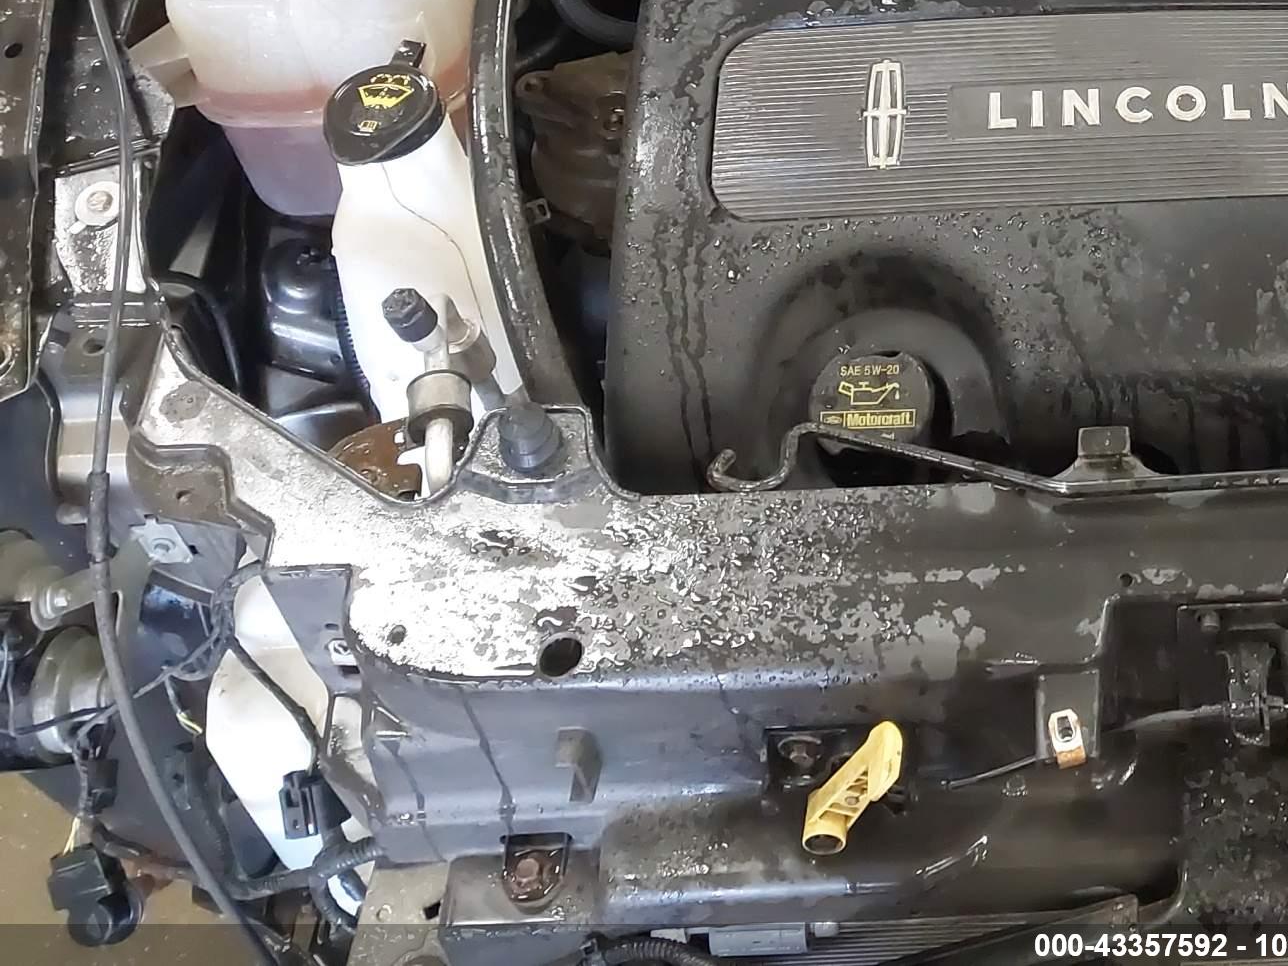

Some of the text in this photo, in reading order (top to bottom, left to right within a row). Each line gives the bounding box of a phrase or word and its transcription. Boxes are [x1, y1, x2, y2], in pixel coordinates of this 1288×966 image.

[840, 364, 900, 376] SAE 5W-20
[846, 412, 913, 426] Motorcraft
